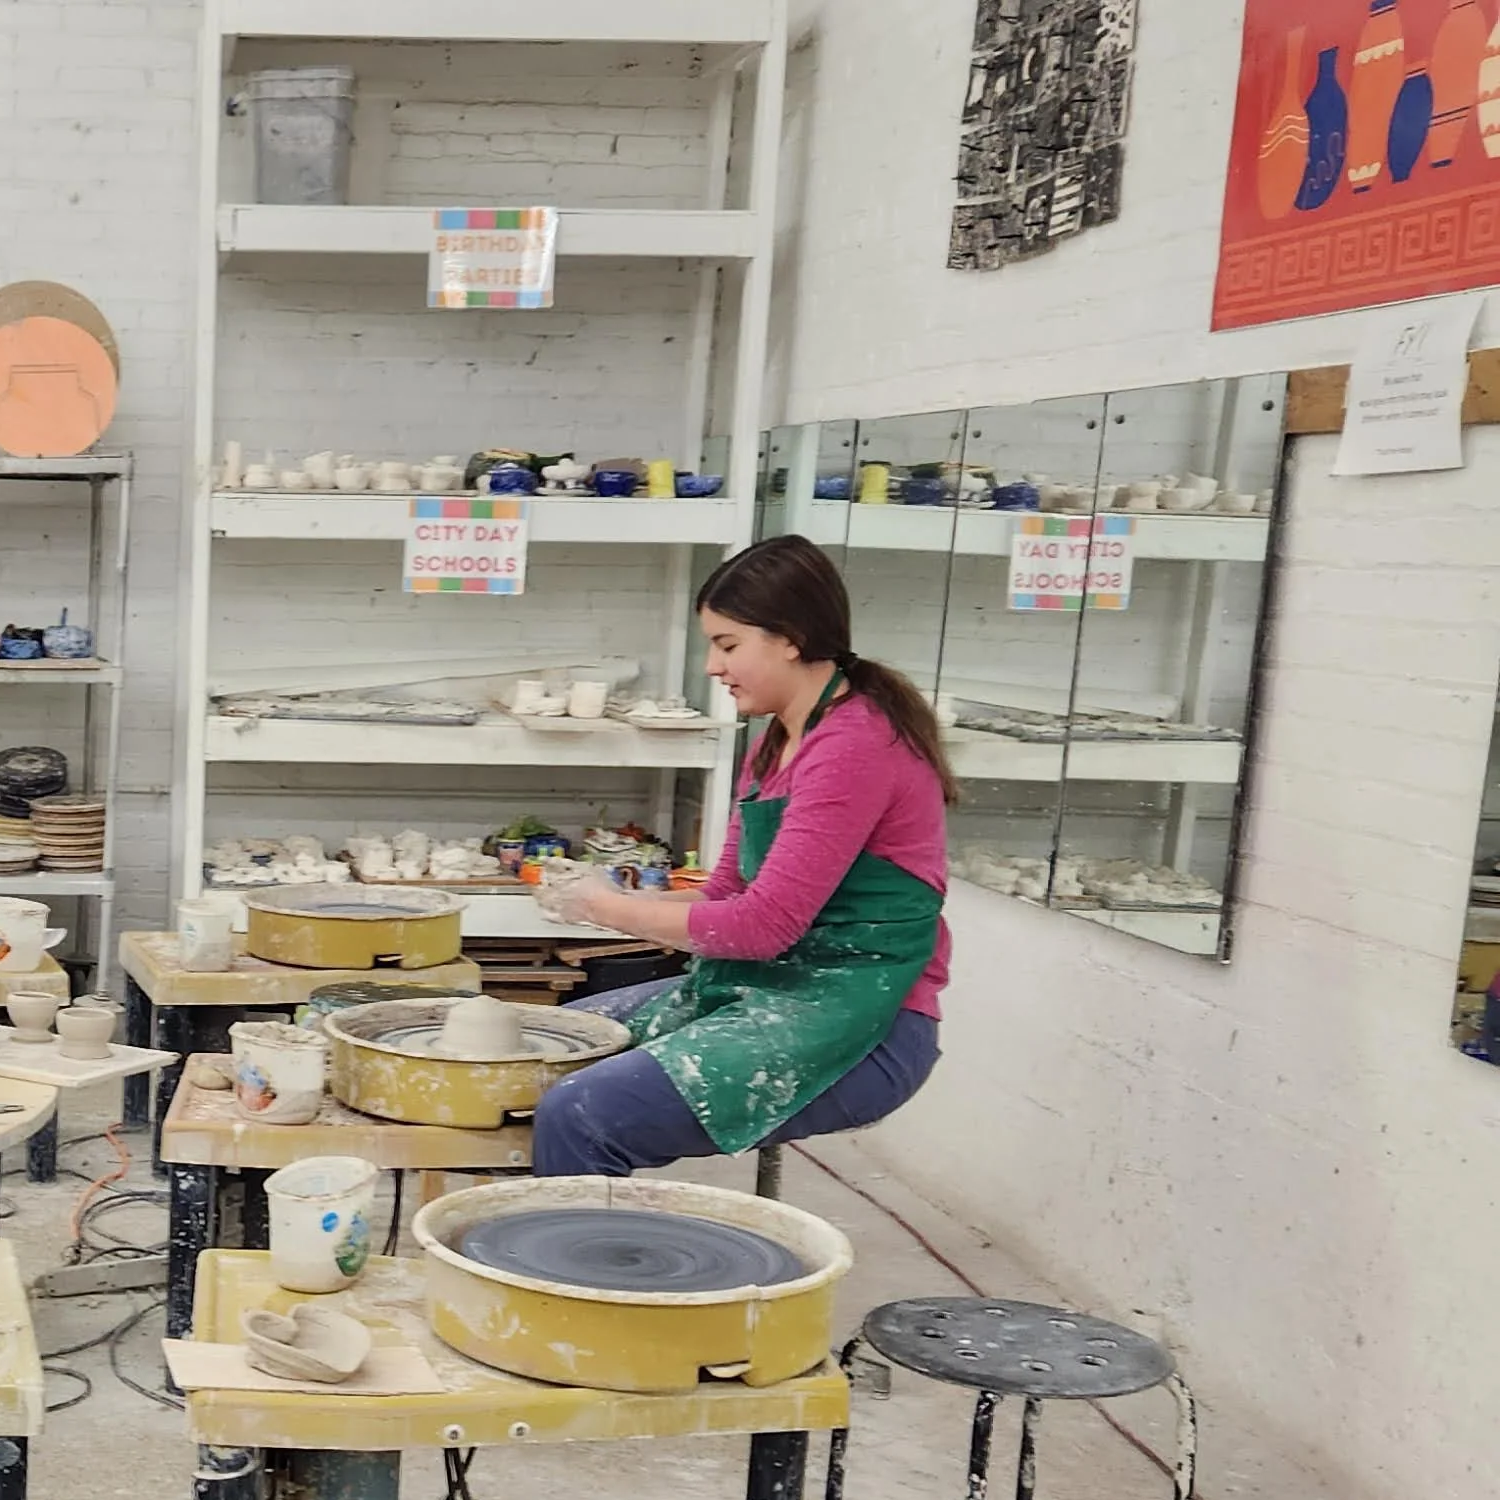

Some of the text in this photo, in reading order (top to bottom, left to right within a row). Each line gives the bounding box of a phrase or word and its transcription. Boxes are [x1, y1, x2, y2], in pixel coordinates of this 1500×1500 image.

[415, 525, 519, 542] CITY DAY
[412, 555, 517, 573] SCHOOLS
